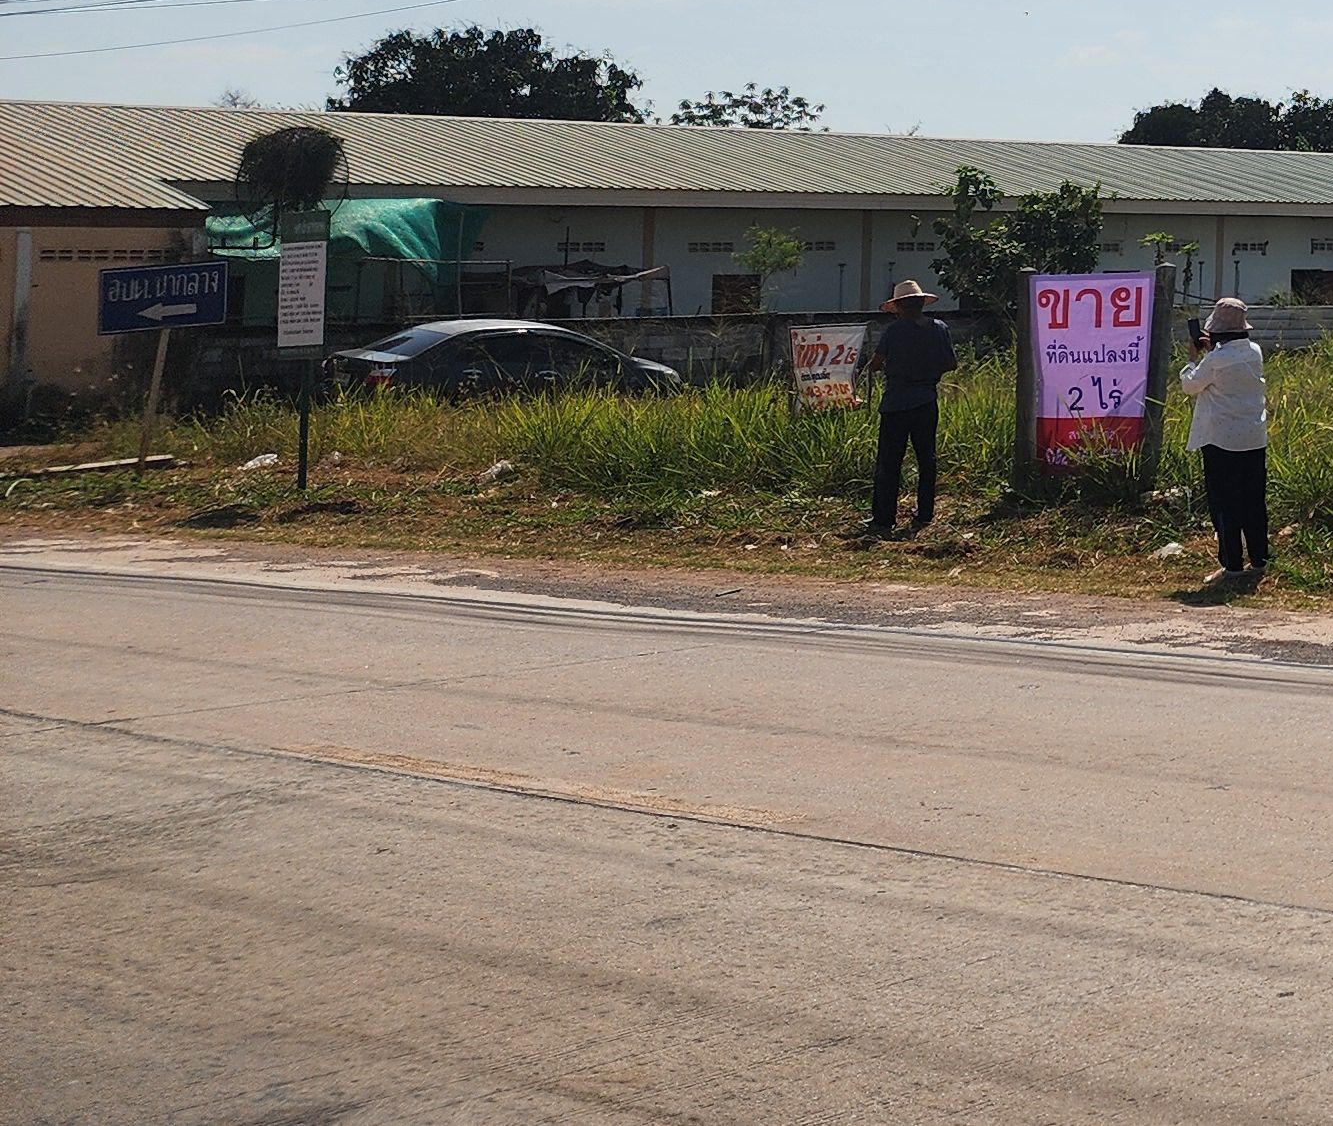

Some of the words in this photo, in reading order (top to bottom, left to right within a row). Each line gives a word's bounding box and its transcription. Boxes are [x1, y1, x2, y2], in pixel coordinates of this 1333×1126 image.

[1037, 286, 1143, 330] ขาย
[829, 344, 845, 365] 2
[1046, 335, 1145, 364] ที่ดินแปลงนี้
[1068, 386, 1084, 411] 2
[1091, 375, 1124, 410] ไร่
